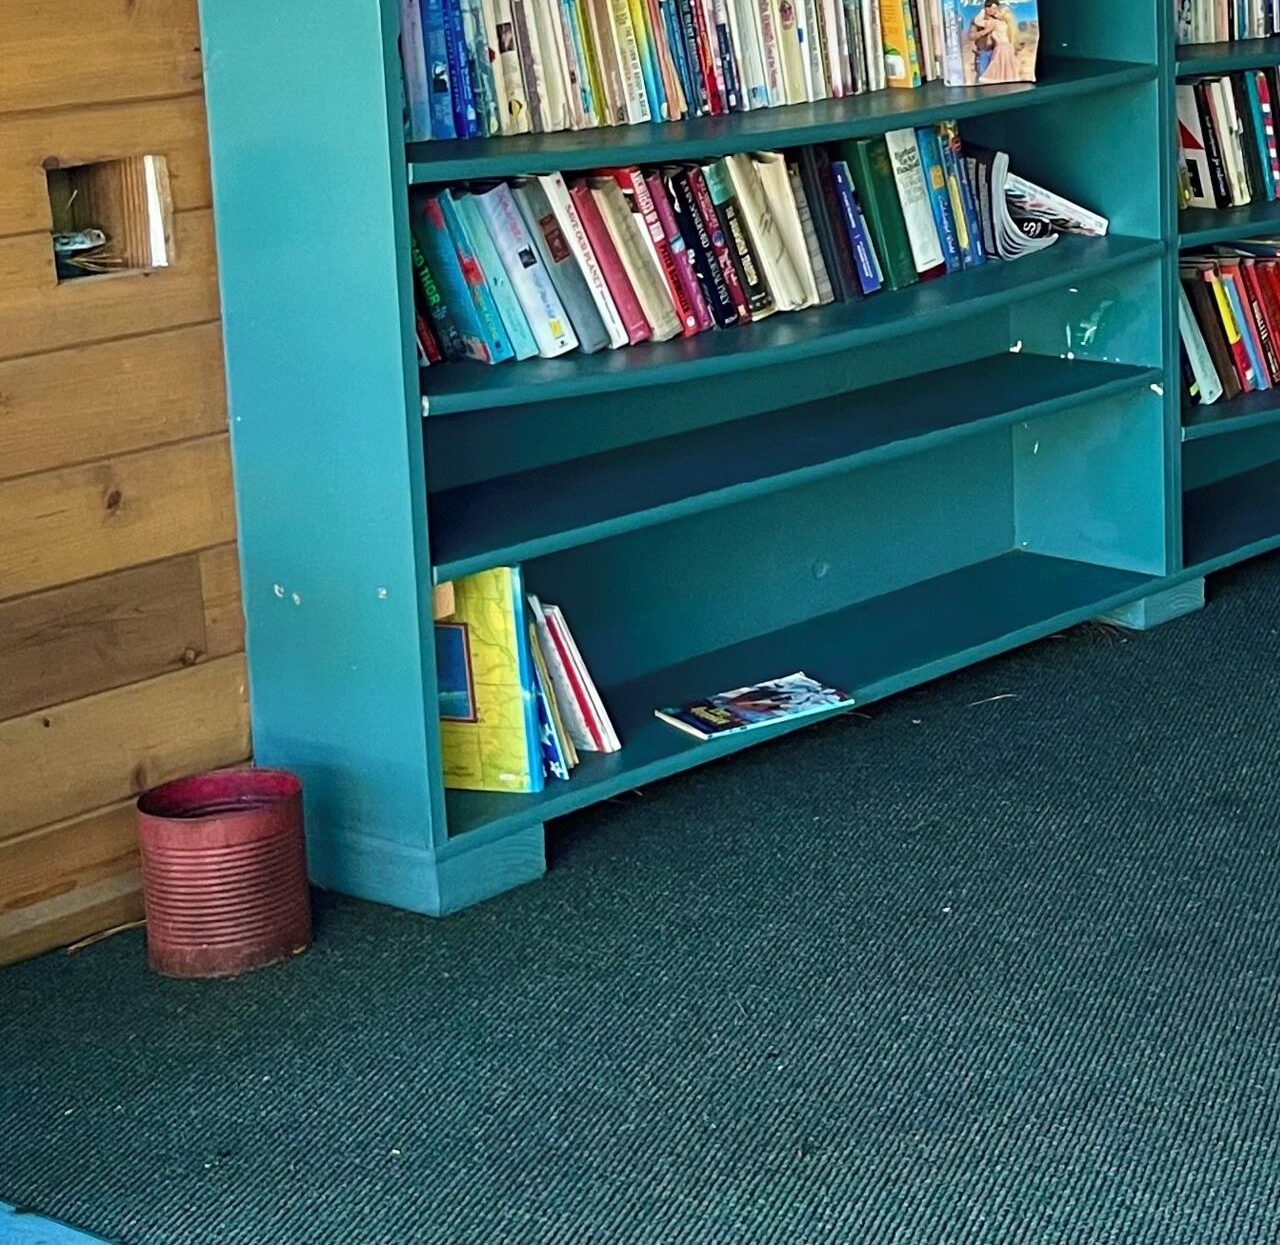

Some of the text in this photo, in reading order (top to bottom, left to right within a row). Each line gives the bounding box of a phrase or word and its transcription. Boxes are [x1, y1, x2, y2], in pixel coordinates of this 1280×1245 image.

[566, 204, 603, 289] SAVE OUR PLANET
[419, 266, 441, 307] THOR
